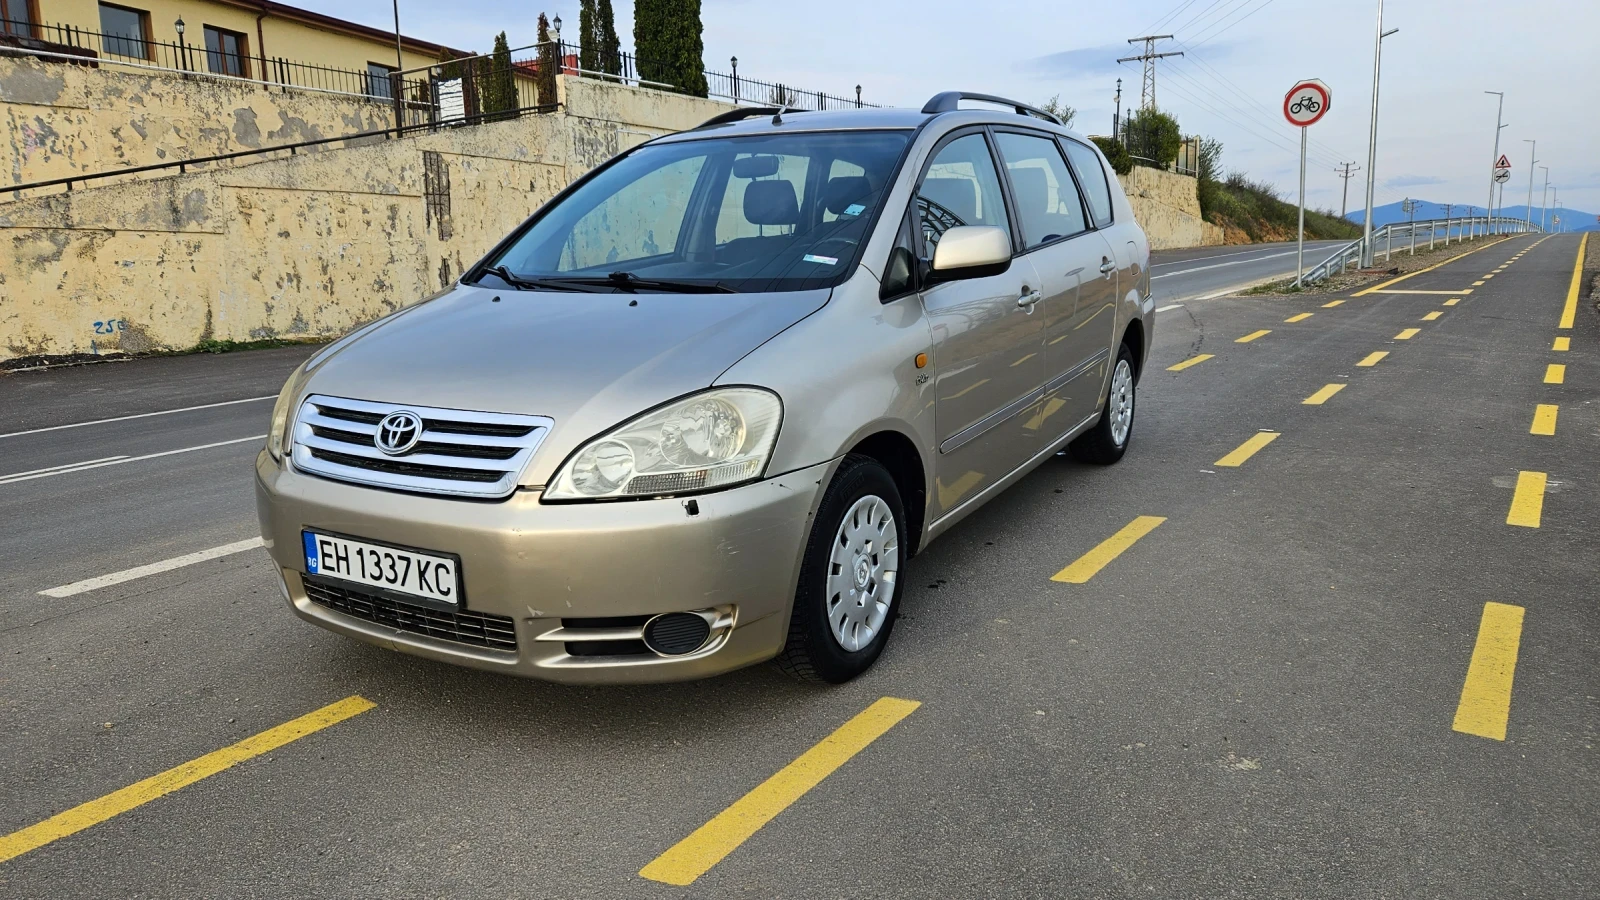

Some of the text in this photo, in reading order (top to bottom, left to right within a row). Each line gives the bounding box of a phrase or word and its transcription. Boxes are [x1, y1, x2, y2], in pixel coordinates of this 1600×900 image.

[319, 539, 451, 597] EH 1337 KC
